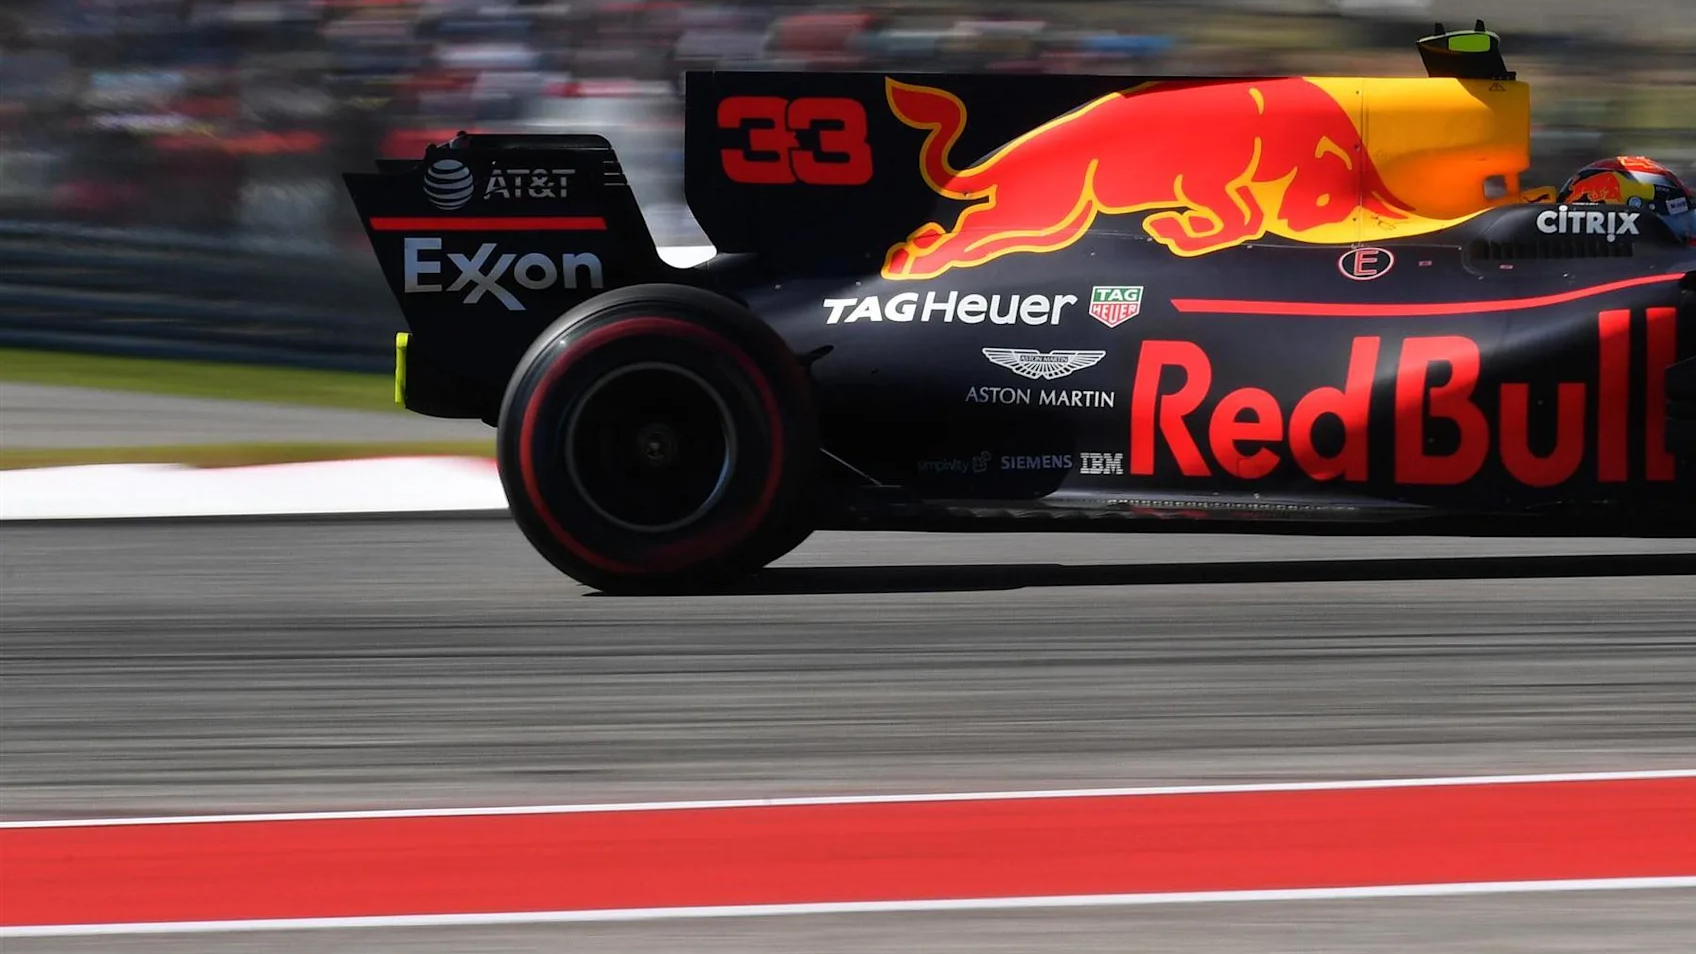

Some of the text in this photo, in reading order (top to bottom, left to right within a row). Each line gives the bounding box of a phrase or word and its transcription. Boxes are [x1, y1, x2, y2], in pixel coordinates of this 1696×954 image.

[717, 96, 874, 185] 33
[483, 168, 576, 200] AT&T
[1353, 248, 1380, 276] E
[404, 237, 604, 311] Exxon
[1096, 289, 1138, 301] TAG
[1093, 304, 1137, 324] HEUER
[965, 386, 1115, 408] ASTON MARTIN
[1001, 454, 1073, 470] SIEMENS
[1080, 452, 1124, 475] IBM
